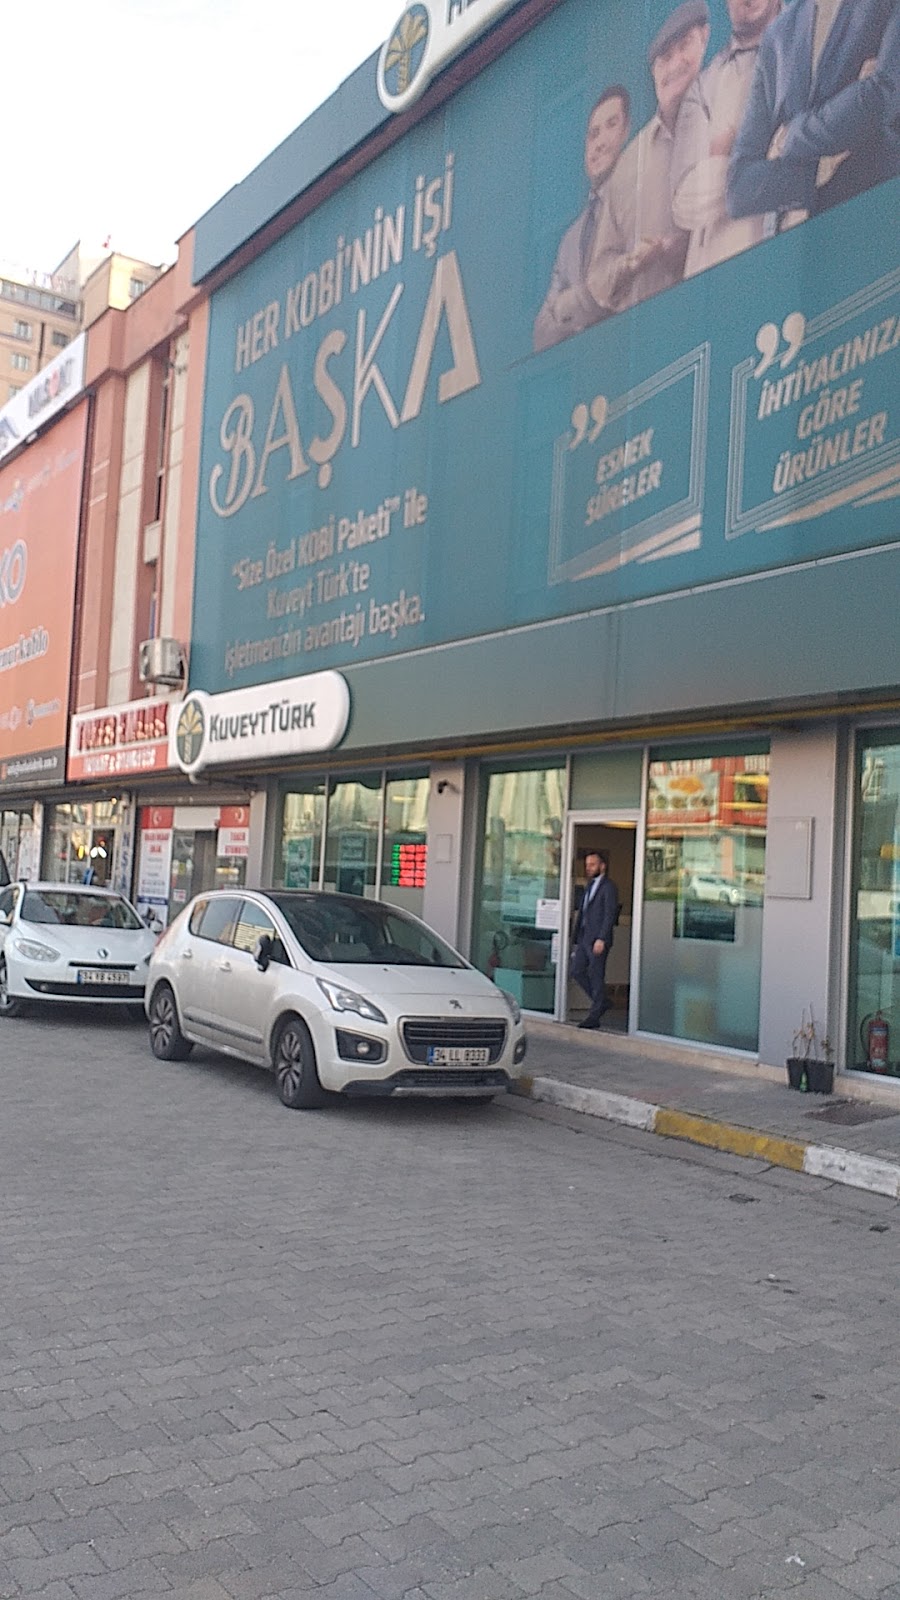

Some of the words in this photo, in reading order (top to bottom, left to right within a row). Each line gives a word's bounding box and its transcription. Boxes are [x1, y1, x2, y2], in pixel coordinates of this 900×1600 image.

[235, 300, 281, 373] HER
[284, 205, 406, 339] KOBİ'NİN
[412, 153, 456, 257] İŞİ
[209, 250, 482, 518] BAŞKA
[797, 378, 864, 440] GÖRE
[596, 427, 655, 484] ESNEK
[772, 411, 888, 494] ÜRÜNLER
[265, 538, 296, 580] Özel
[298, 513, 335, 568] KOBİ
[403, 486, 429, 529] ile
[267, 577, 314, 619] Kuveyt
[369, 588, 426, 640] başka.
[433, 1049, 446, 1061] 34
